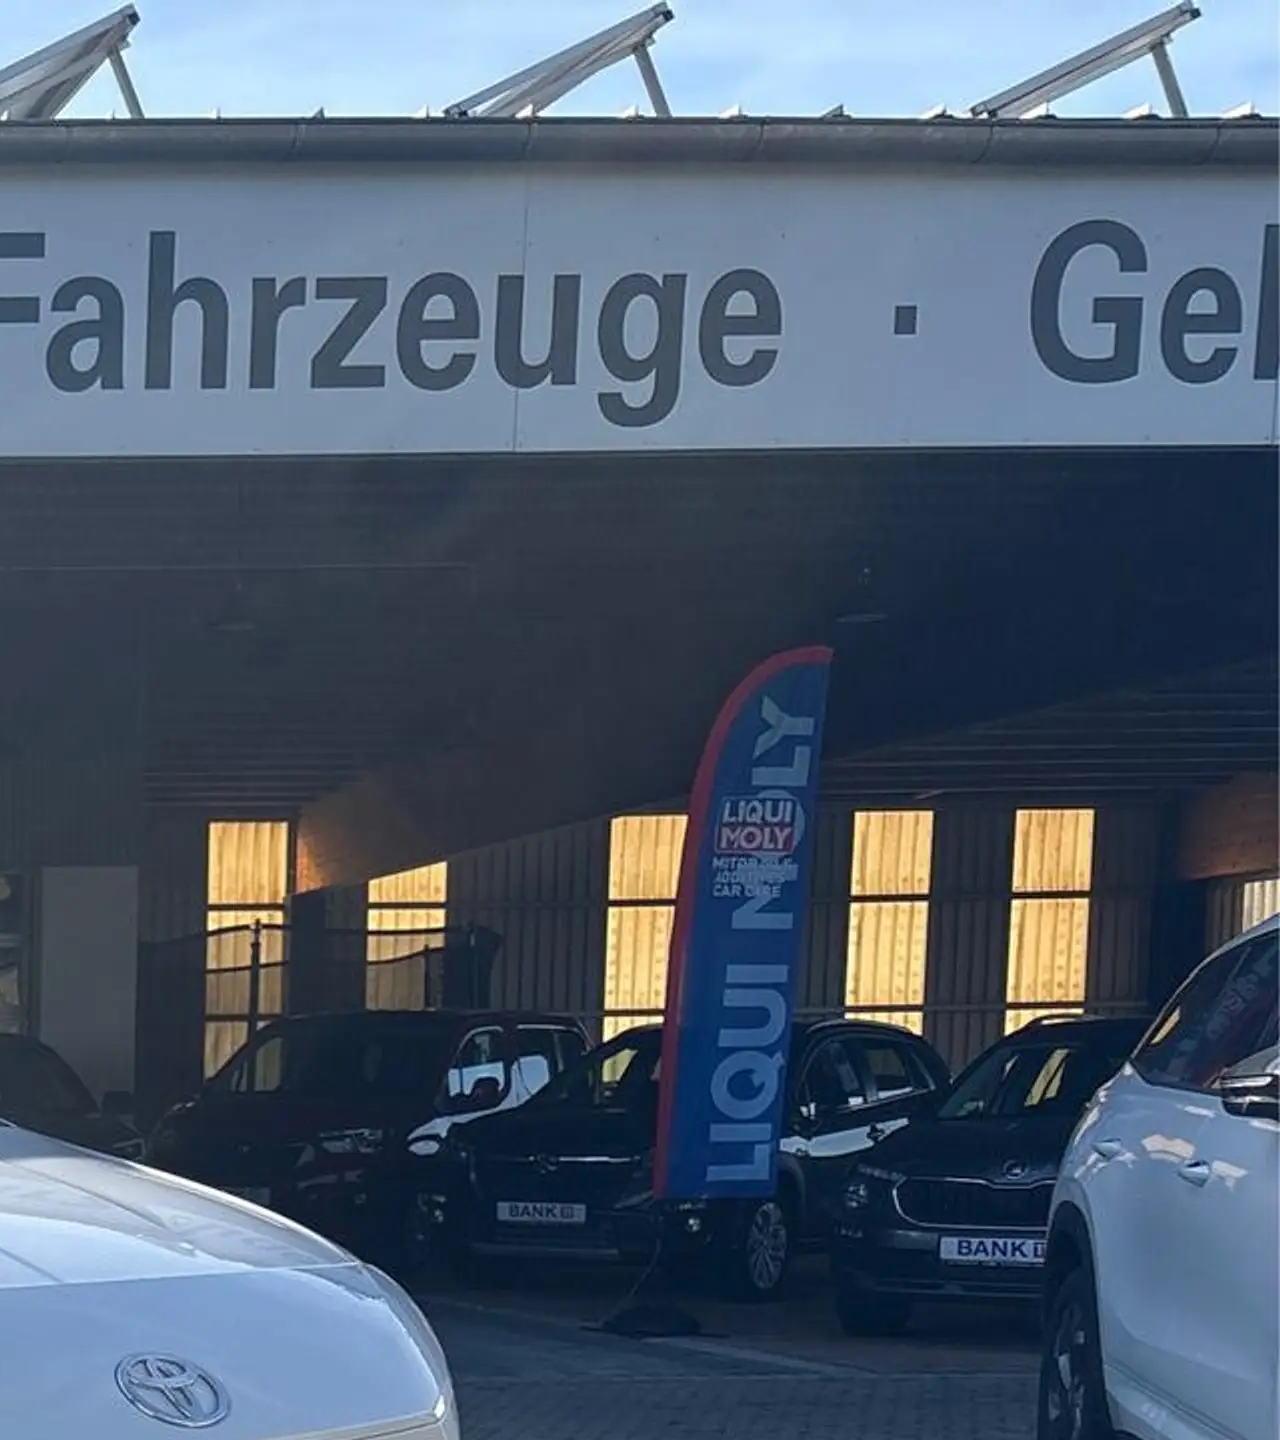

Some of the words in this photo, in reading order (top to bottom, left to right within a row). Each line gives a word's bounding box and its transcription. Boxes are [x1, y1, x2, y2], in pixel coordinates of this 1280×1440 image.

[721, 799, 794, 824] LIQUI
[730, 694, 815, 930] MLY
[719, 826, 793, 850] MOLY
[712, 883, 743, 898] CAR
[705, 964, 790, 1183] LIQUI
[956, 1239, 1030, 1258] BANK
